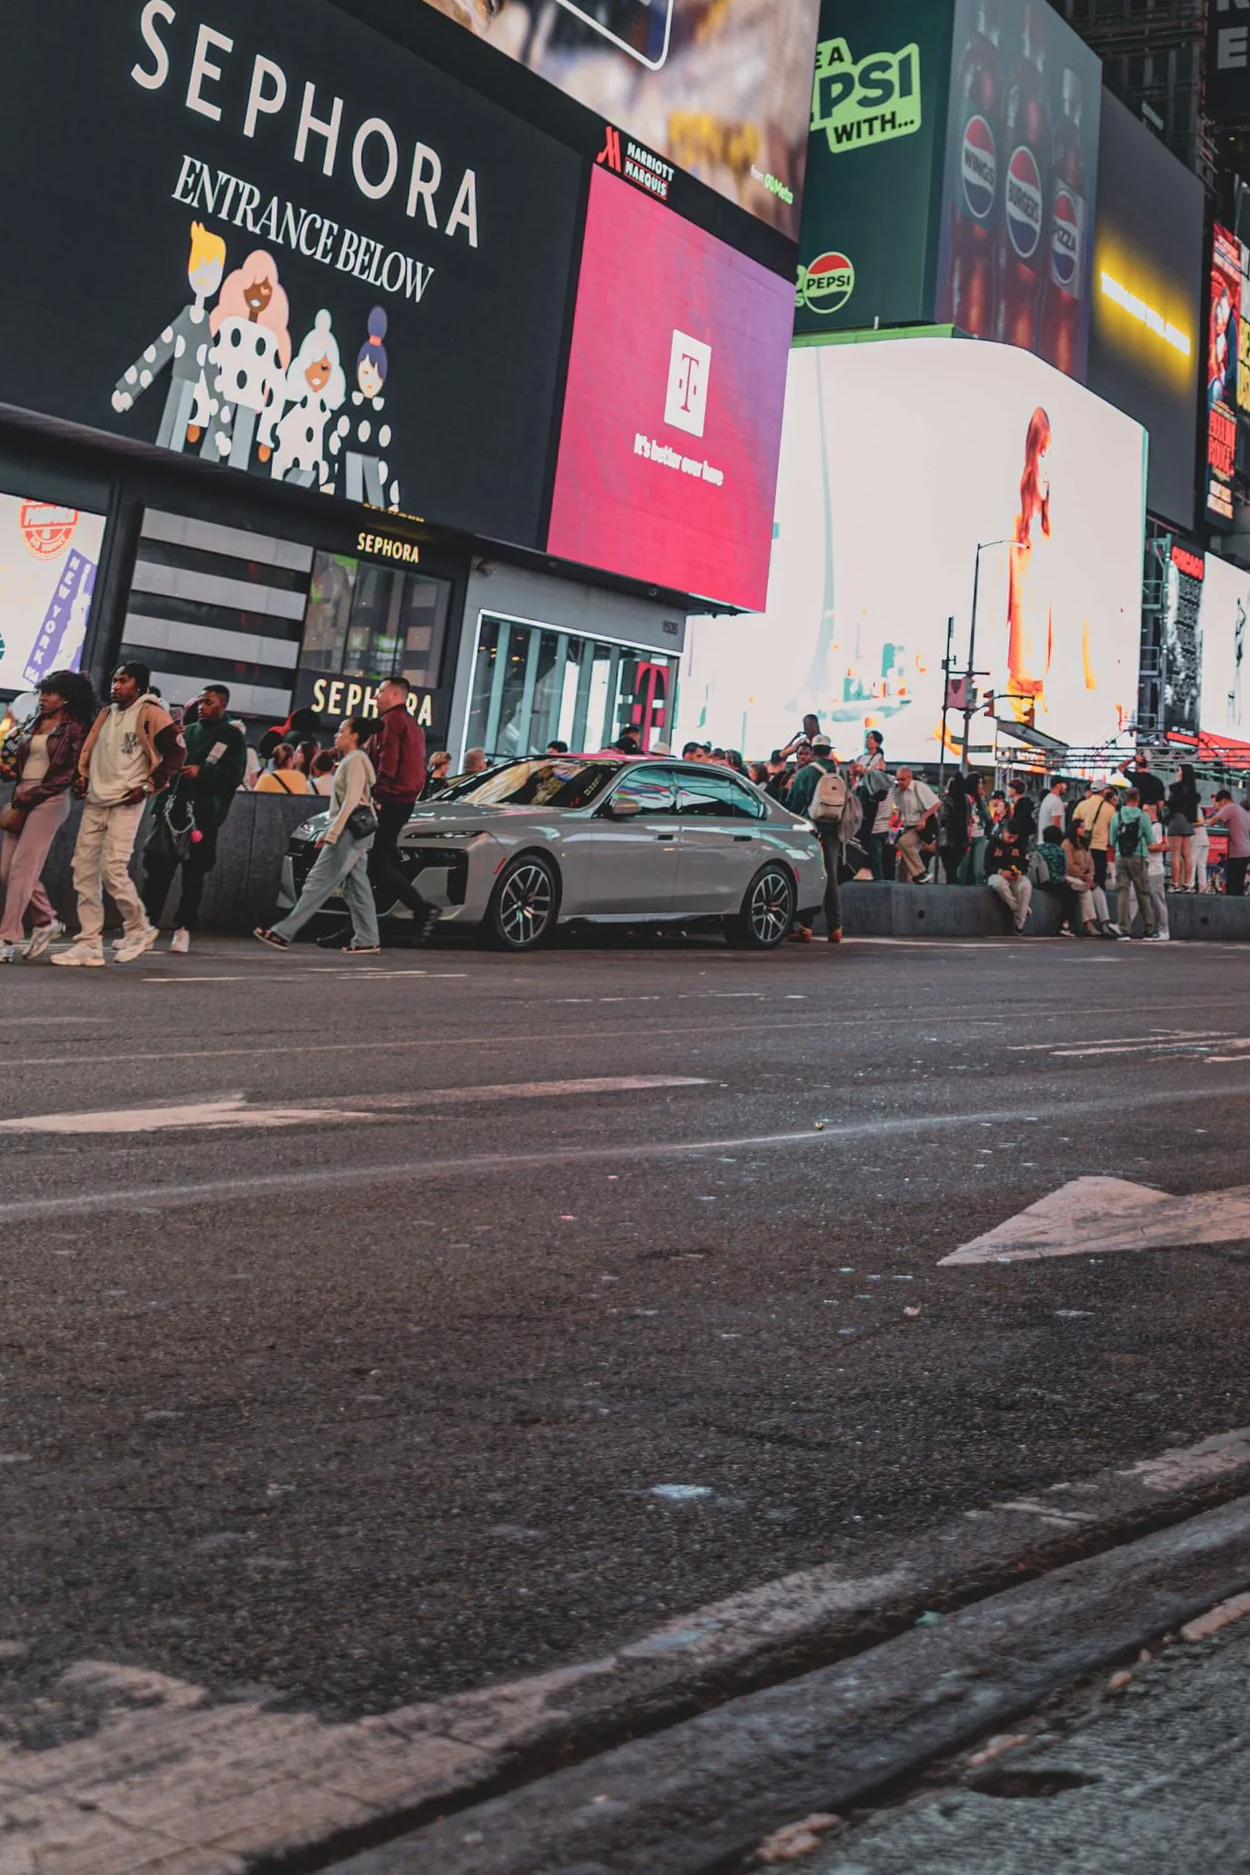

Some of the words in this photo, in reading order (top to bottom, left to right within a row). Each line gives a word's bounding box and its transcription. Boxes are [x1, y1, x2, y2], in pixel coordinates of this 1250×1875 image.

[828, 46, 845, 67] A
[809, 52, 914, 123] PSI
[131, 0, 478, 248] SEPHORA
[833, 110, 915, 145] WITH...
[625, 161, 668, 198] MARQUIS
[627, 141, 674, 182] MARRIOTT
[964, 145, 995, 187] WINGS
[1008, 178, 1041, 225] BURGERS
[171, 154, 339, 265] ENTRANCE
[335, 228, 435, 303] BELOW
[806, 274, 851, 291] PEPSI
[634, 433, 651, 458] It's
[650, 439, 682, 470] better
[357, 532, 420, 564] SEPHORA
[57, 555, 81, 600] NEW
[32, 604, 62, 665] YORK
[311, 678, 433, 727] SEPHRA
